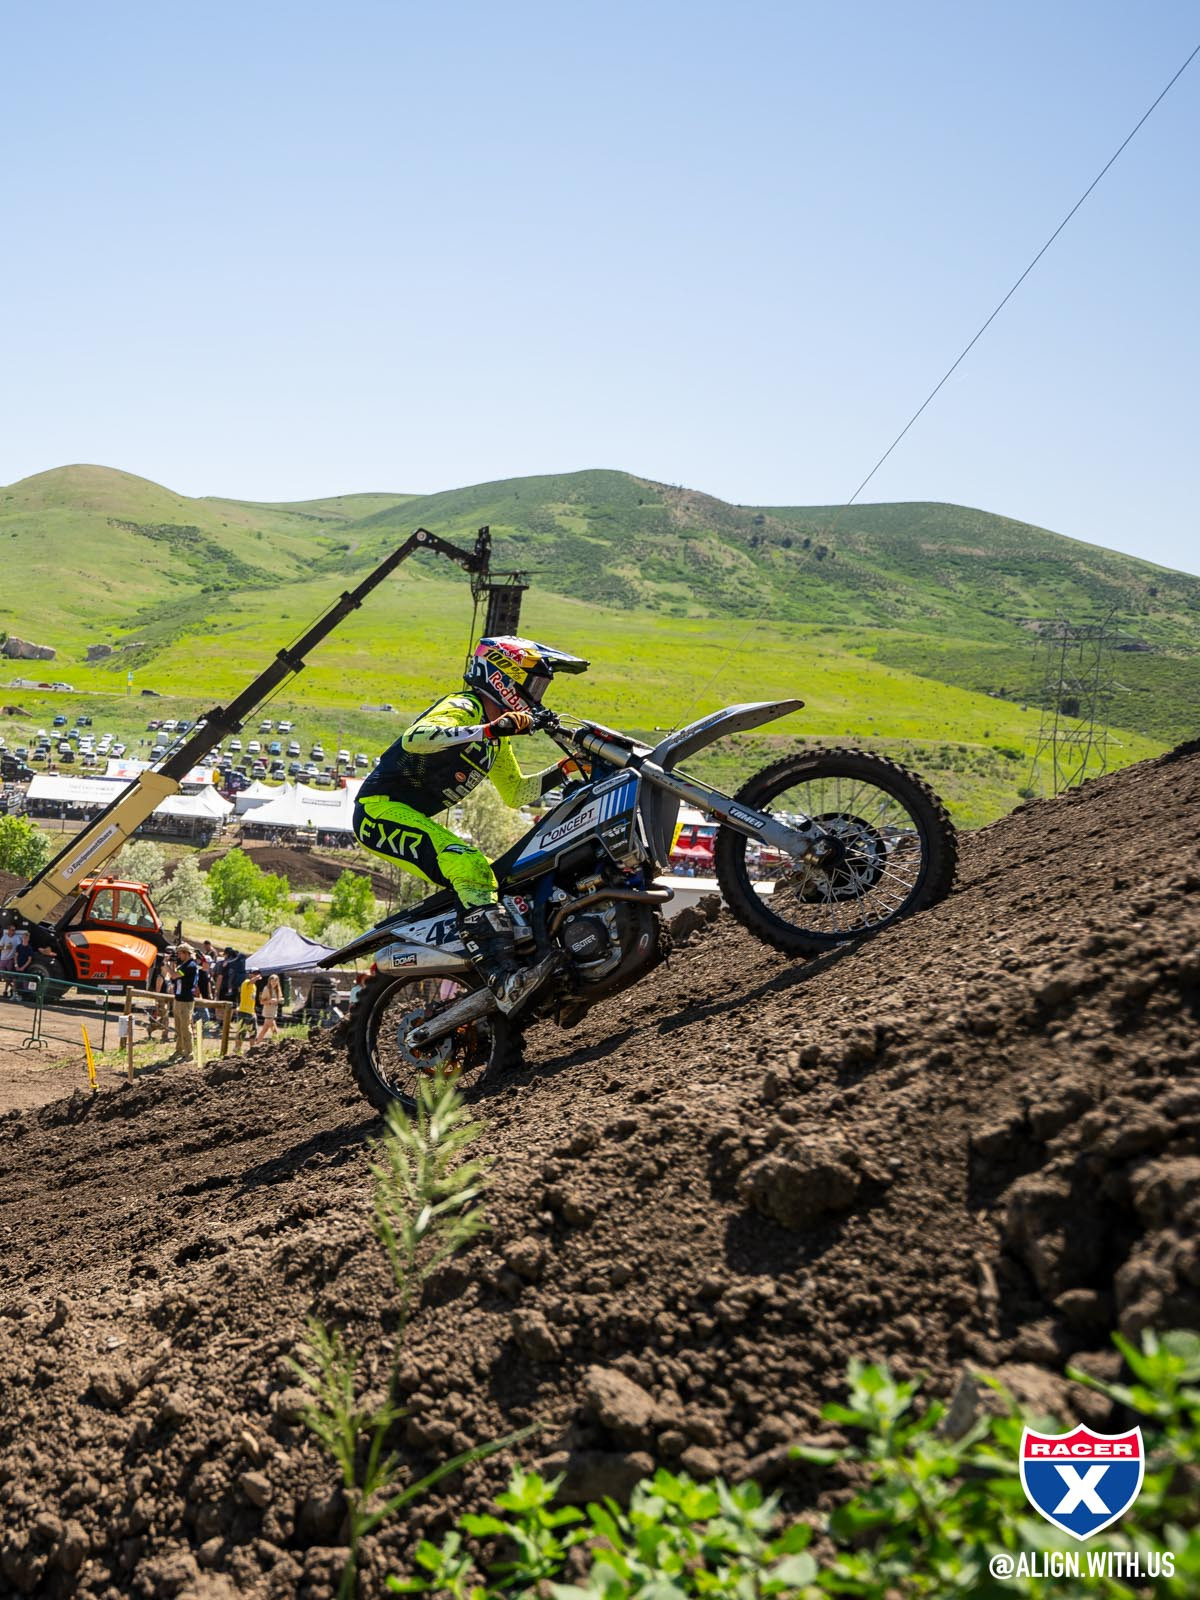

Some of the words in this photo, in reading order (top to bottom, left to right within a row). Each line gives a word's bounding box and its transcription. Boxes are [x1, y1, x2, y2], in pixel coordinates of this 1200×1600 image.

[359, 817, 423, 860] FXR
[539, 807, 596, 850] CONCEPT
[394, 954, 415, 965] DOMA
